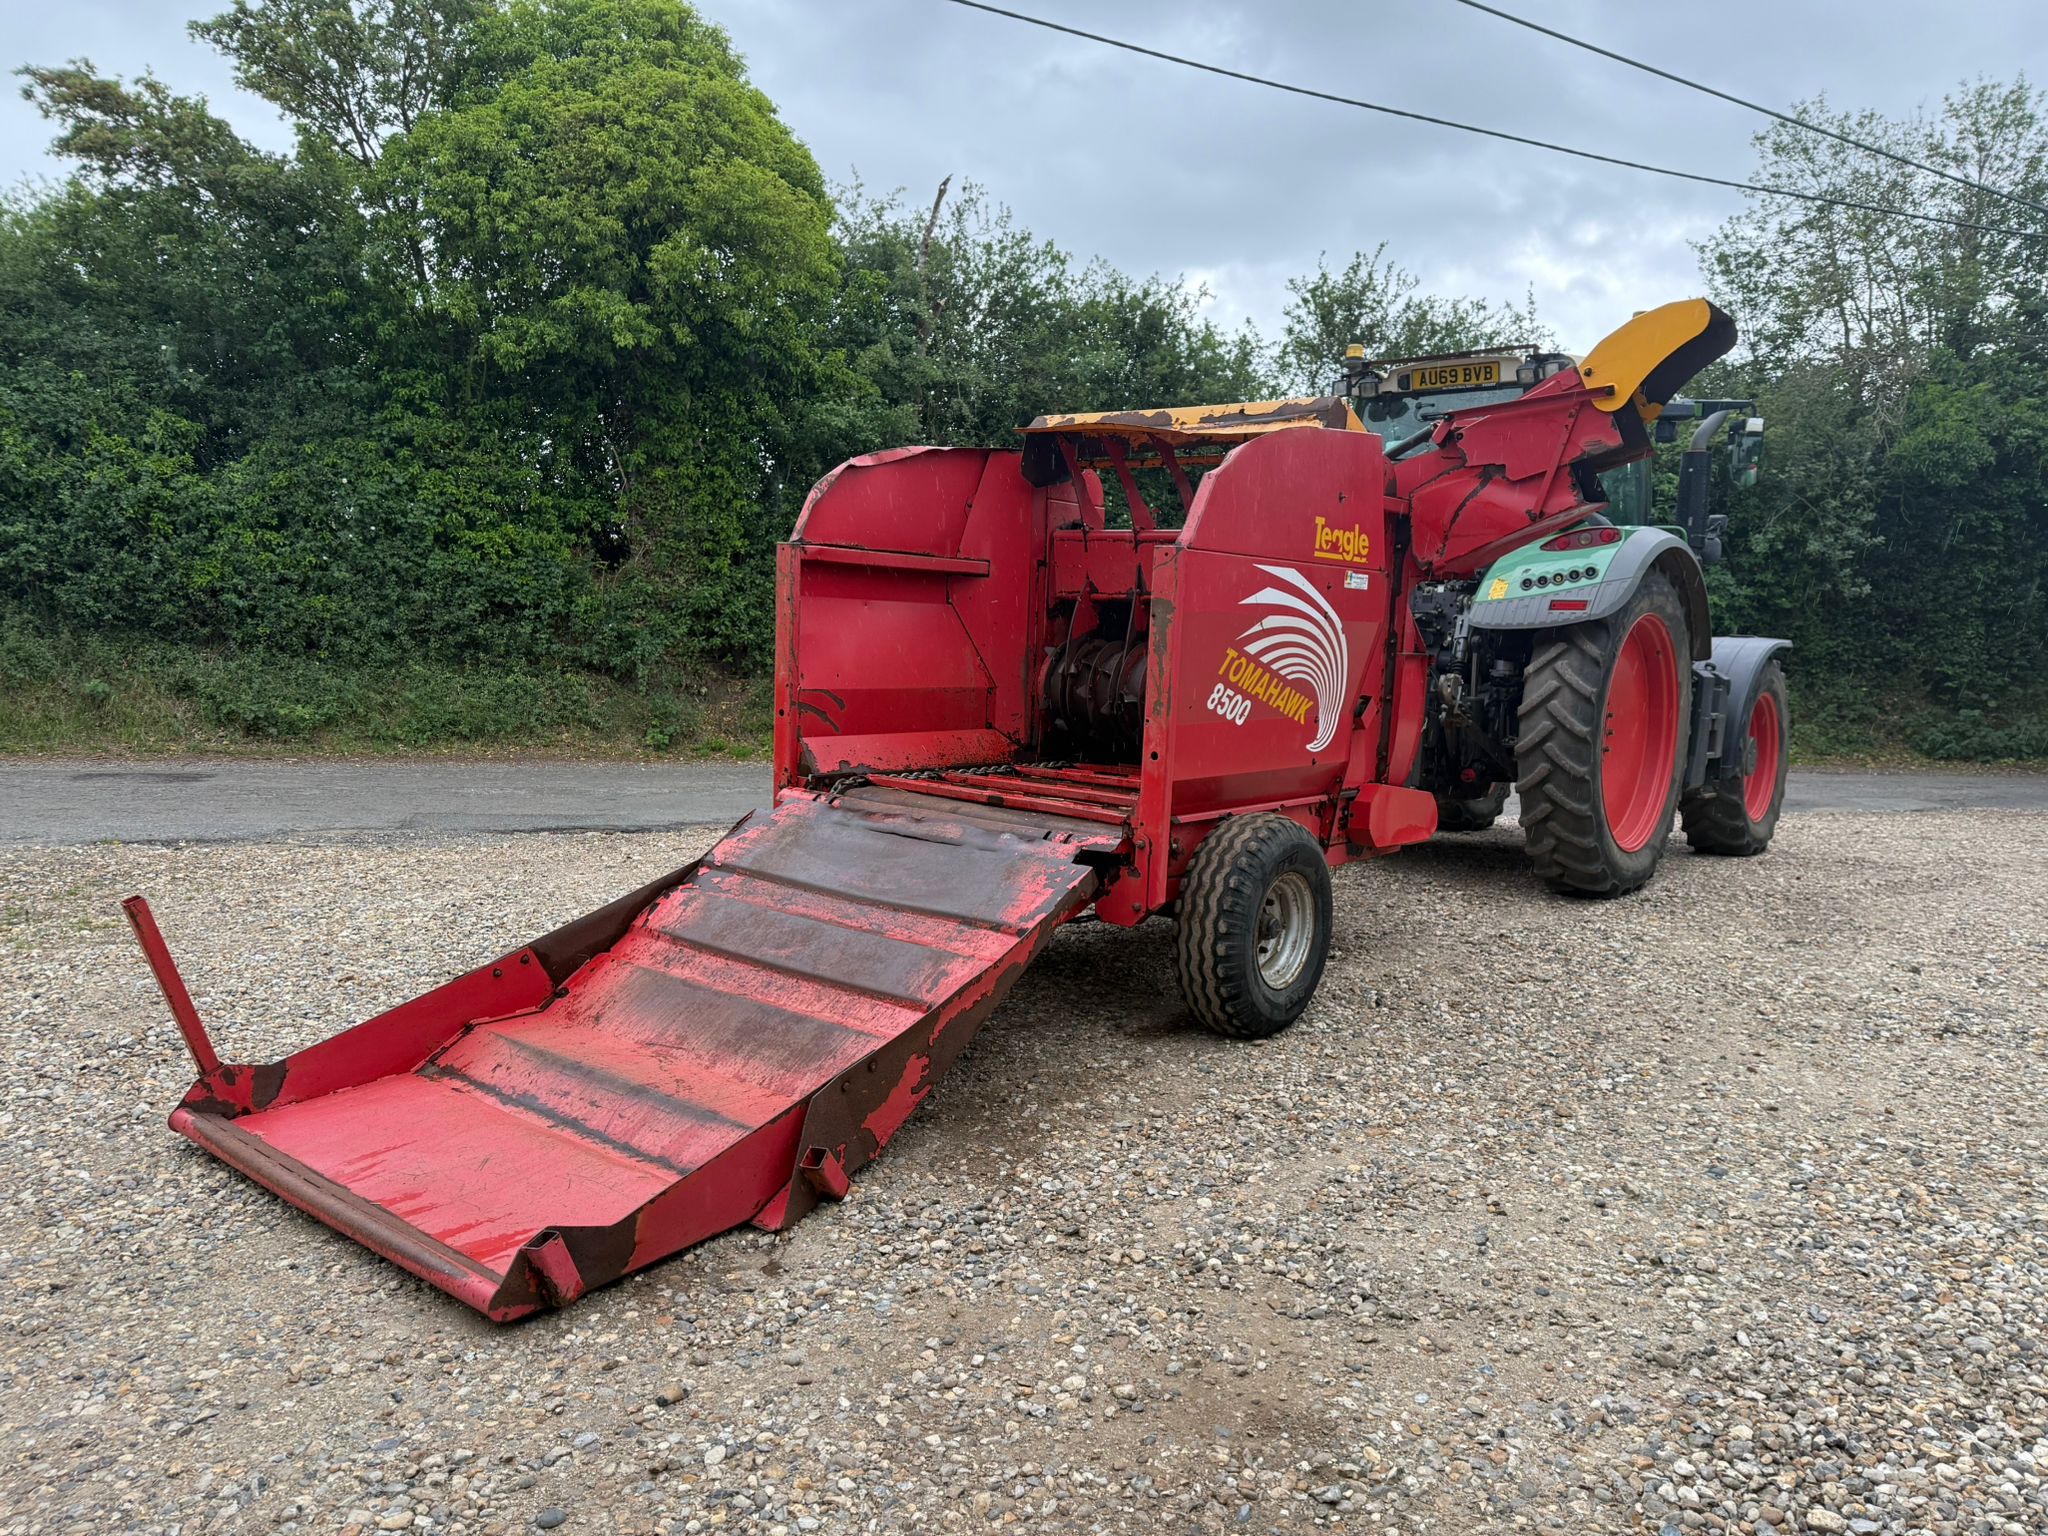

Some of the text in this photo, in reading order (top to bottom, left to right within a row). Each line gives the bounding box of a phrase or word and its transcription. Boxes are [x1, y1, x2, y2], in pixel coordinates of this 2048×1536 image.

[1419, 365, 1493, 386] AU69 BVB
[1315, 516, 1369, 561] Teagle
[1207, 683, 1252, 726] 8500
[1218, 647, 1314, 725] TOMAHAWK
